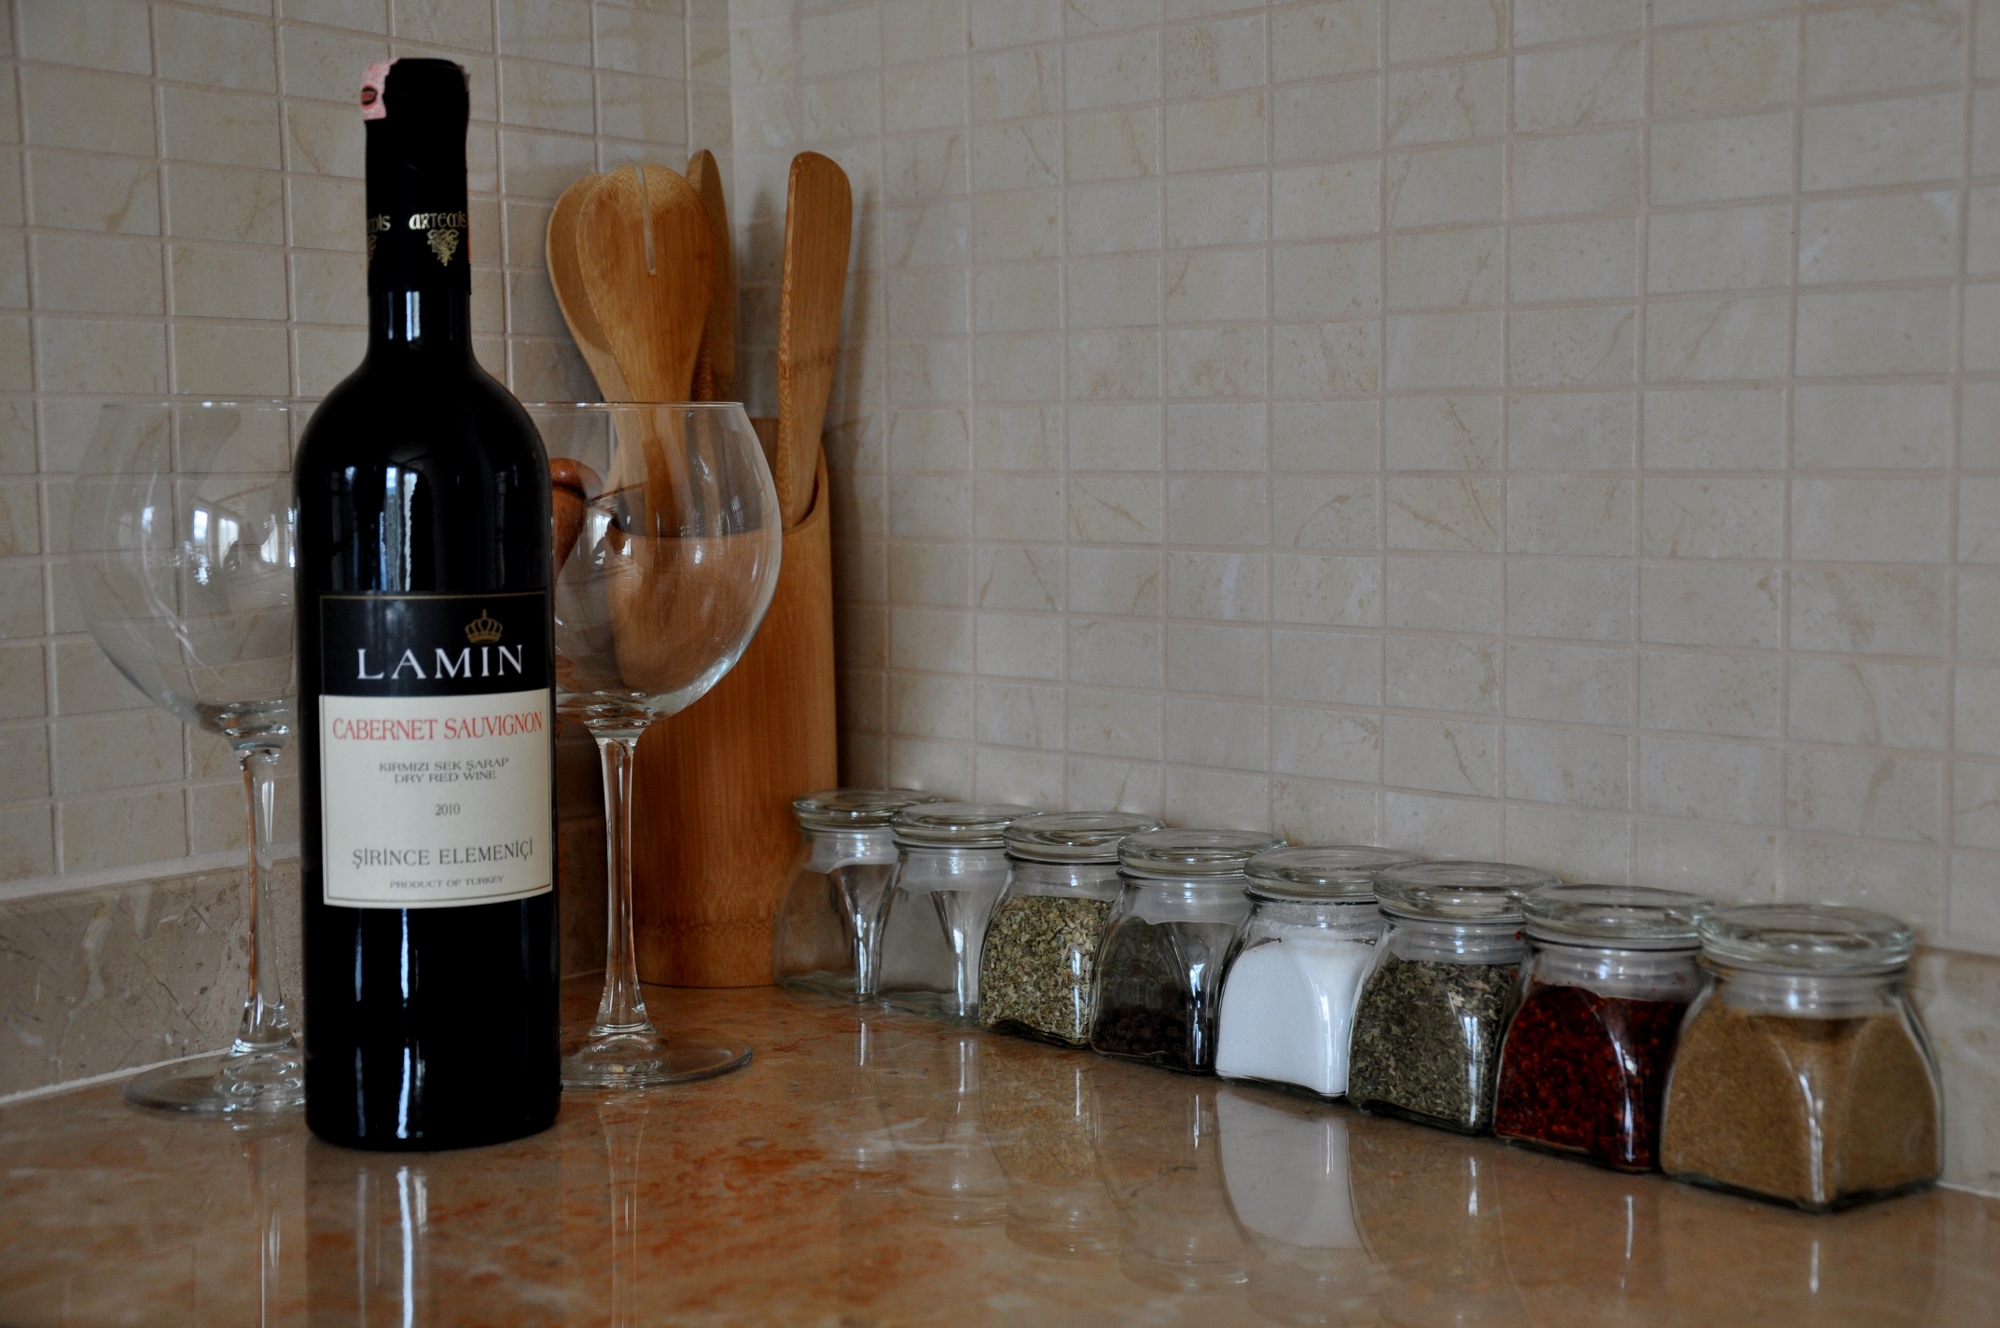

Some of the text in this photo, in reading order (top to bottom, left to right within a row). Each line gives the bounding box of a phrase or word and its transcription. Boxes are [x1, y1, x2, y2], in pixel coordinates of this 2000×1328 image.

[357, 644, 523, 680] LAMIN
[332, 711, 543, 741] CABERNET SAUVIGNON
[379, 757, 509, 773] KIRMIZI SEK ŞARAP
[394, 770, 497, 784] DRY RED WINE
[435, 803, 461, 816] 2010
[352, 847, 430, 869] ŞİRİNCE
[390, 880, 443, 889] PRODUCT
[465, 875, 504, 886] TURKEY
